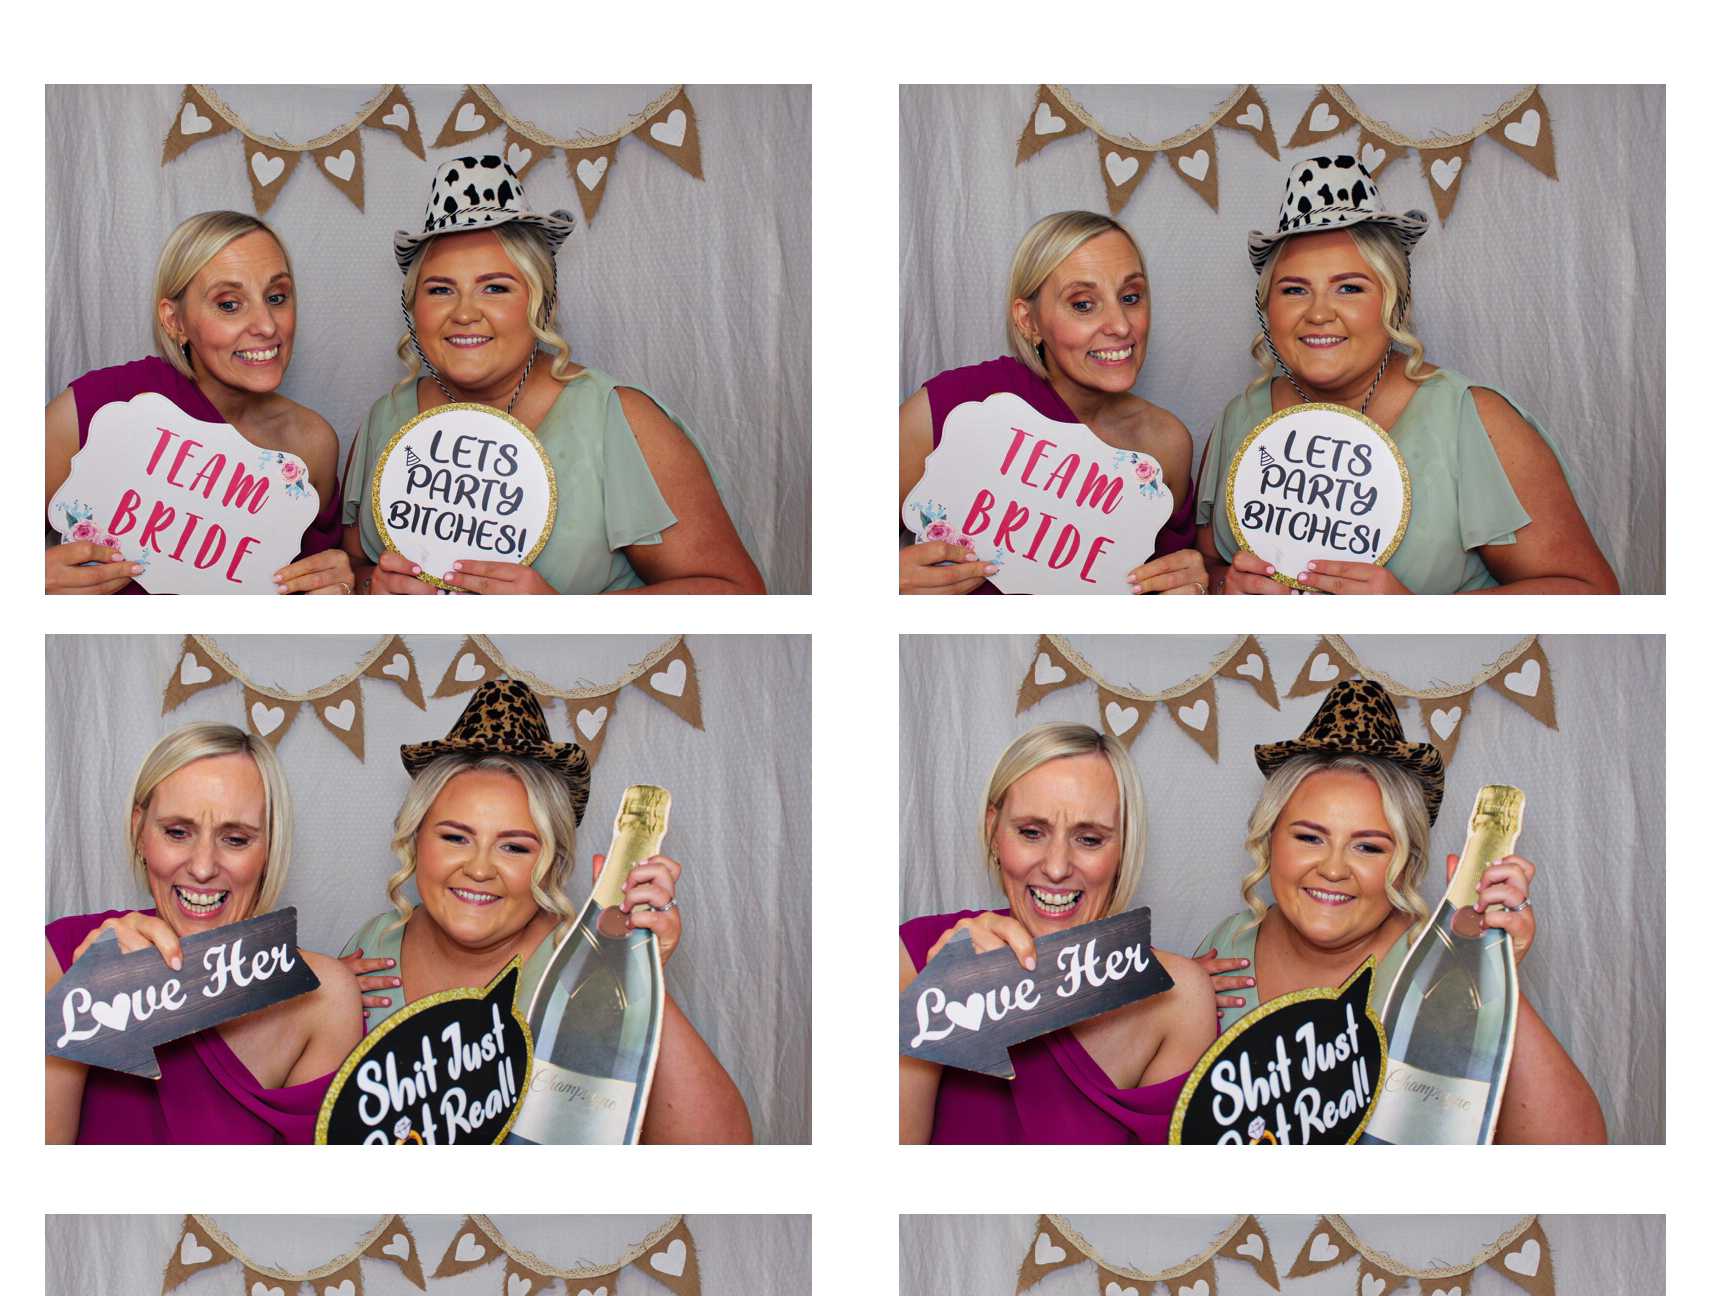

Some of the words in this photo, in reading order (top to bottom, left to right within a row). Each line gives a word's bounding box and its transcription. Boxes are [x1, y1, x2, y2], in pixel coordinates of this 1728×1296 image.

[146, 427, 270, 514] TEAM
[406, 464, 524, 516] PARTY
[430, 430, 518, 477] LETS
[1000, 427, 1124, 514] TEAM
[1260, 464, 1378, 516] PARTY
[1284, 430, 1372, 477] LETS
[107, 489, 261, 583] BRIDE
[387, 500, 527, 558] BITCHES!
[961, 489, 1115, 583] BRIDE
[1241, 500, 1381, 558] BITCHES!
[202, 938, 296, 998] Her
[1056, 938, 1150, 998] Her
[356, 1035, 438, 1126] Shit
[441, 1003, 505, 1081] Just
[440, 1056, 518, 1145] Real!
[1210, 1035, 1292, 1126] Shit
[1295, 1003, 1359, 1081] Just
[1294, 1056, 1372, 1145] Real!
